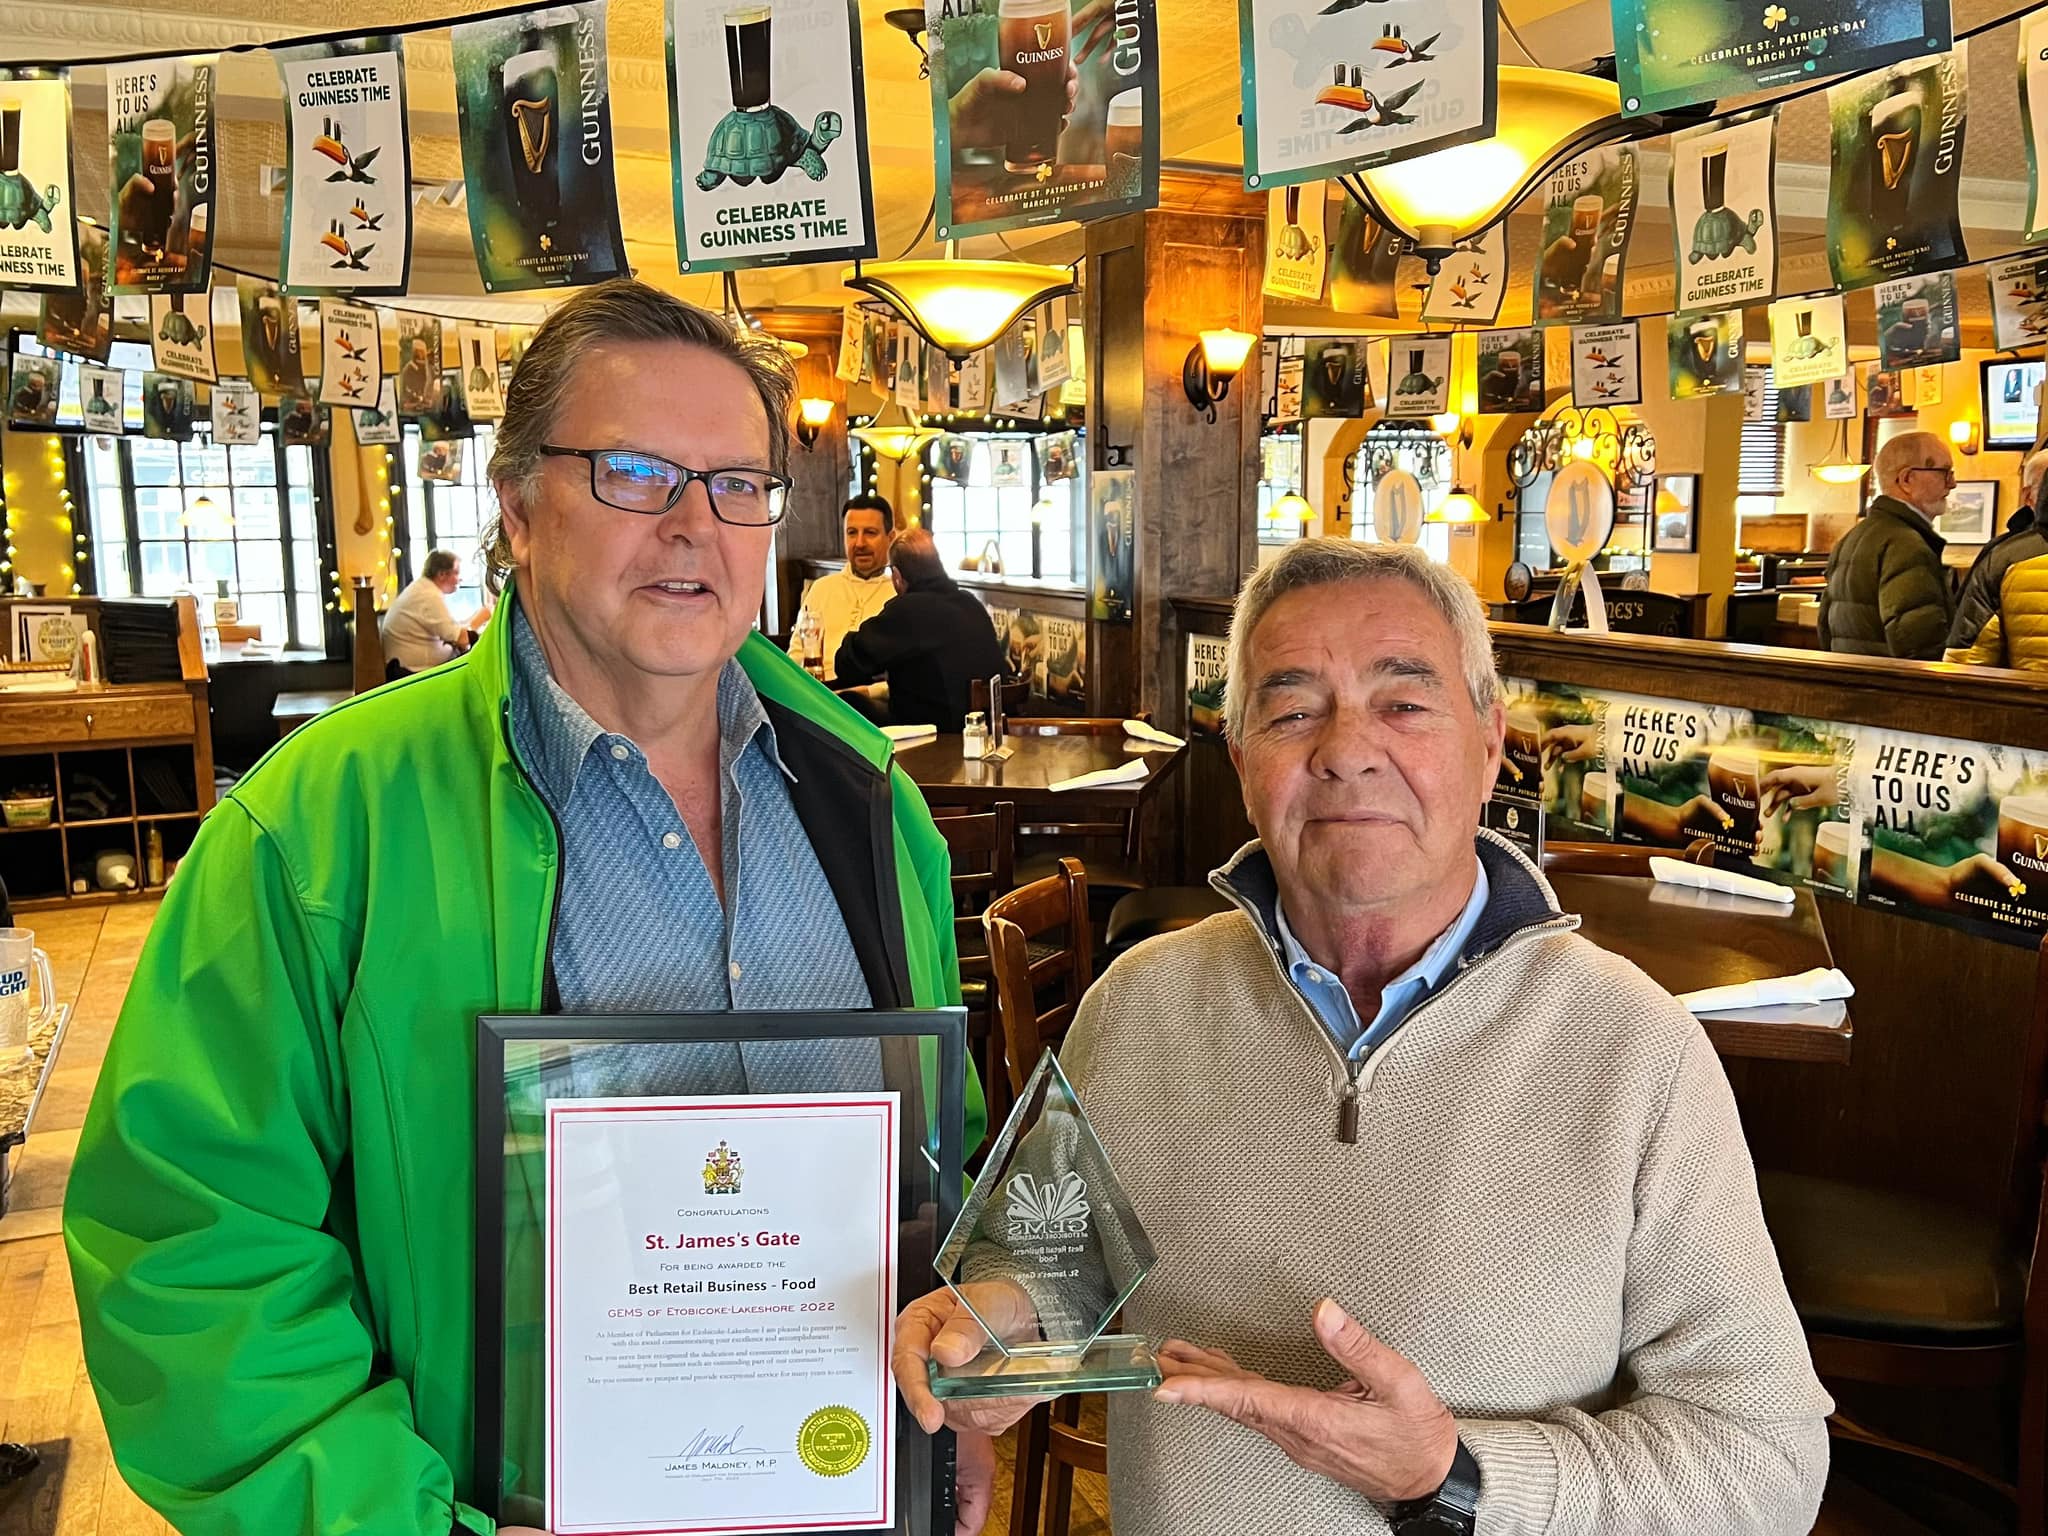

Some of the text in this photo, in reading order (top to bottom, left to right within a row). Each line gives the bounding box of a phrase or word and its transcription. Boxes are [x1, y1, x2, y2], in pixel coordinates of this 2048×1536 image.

[1690, 19, 1866, 65] CELEBRATE ST. PATRICK'S DAY
[1016, 46, 1064, 65] GUINNESS
[1746, 51, 1785, 67] MARCH
[116, 74, 157, 95] HERE'S
[307, 67, 378, 87] CELEBRATE
[299, 85, 391, 107] GUINNESS TIME
[582, 18, 603, 167] GUINNESS
[116, 94, 149, 115] TO US
[116, 117, 136, 134] ALL
[1934, 57, 1957, 176] GUINNESS
[194, 66, 209, 195] GUINNESS
[985, 179, 1105, 206] CELEBRATE ST. PATRICK'S DAY
[1551, 178, 1581, 194] TO US
[1022, 199, 1050, 209] MARCH
[1611, 152, 1633, 248] GUINNESS
[716, 199, 827, 226] CELEBRATE
[699, 218, 848, 249] GUINNESS TIME
[0, 245, 52, 260] LEBRATE
[0, 261, 66, 276] NNESS TIME
[1697, 266, 1755, 287] CELEBRATE
[1687, 278, 1764, 302] GUINNESS TIME
[1585, 328, 1624, 338] CELEBRATE
[1194, 644, 1226, 661] HERE'S
[1194, 661, 1220, 678] TO US
[1624, 705, 1698, 738] HERE'S
[1623, 731, 1680, 762] TO US
[1622, 757, 1654, 780] ALL
[1875, 744, 1975, 785] HERE'S
[1722, 792, 1756, 810] GUINNESS
[1872, 774, 1951, 812] TO US
[1874, 804, 1921, 835] ALL
[1715, 843, 1731, 854] ARCH
[1955, 892, 1998, 910] CELEBRATE
[2016, 906, 2048, 921] PATRIC
[1992, 911, 2021, 925] MARCH
[0, 971, 23, 984] UD
[0, 979, 26, 997] GHT
[645, 1231, 801, 1250] St. James's Gate
[660, 1260, 786, 1272] FOR BEING AWARDED THE
[628, 1283, 659, 1295] Best
[663, 1281, 703, 1294] Retail
[707, 1279, 767, 1293] Business
[781, 1277, 816, 1290] Food
[607, 1308, 643, 1318] GEMS
[647, 1308, 662, 1317] OF
[800, 1302, 836, 1312] 2022
[664, 1463, 698, 1472] JAMES
